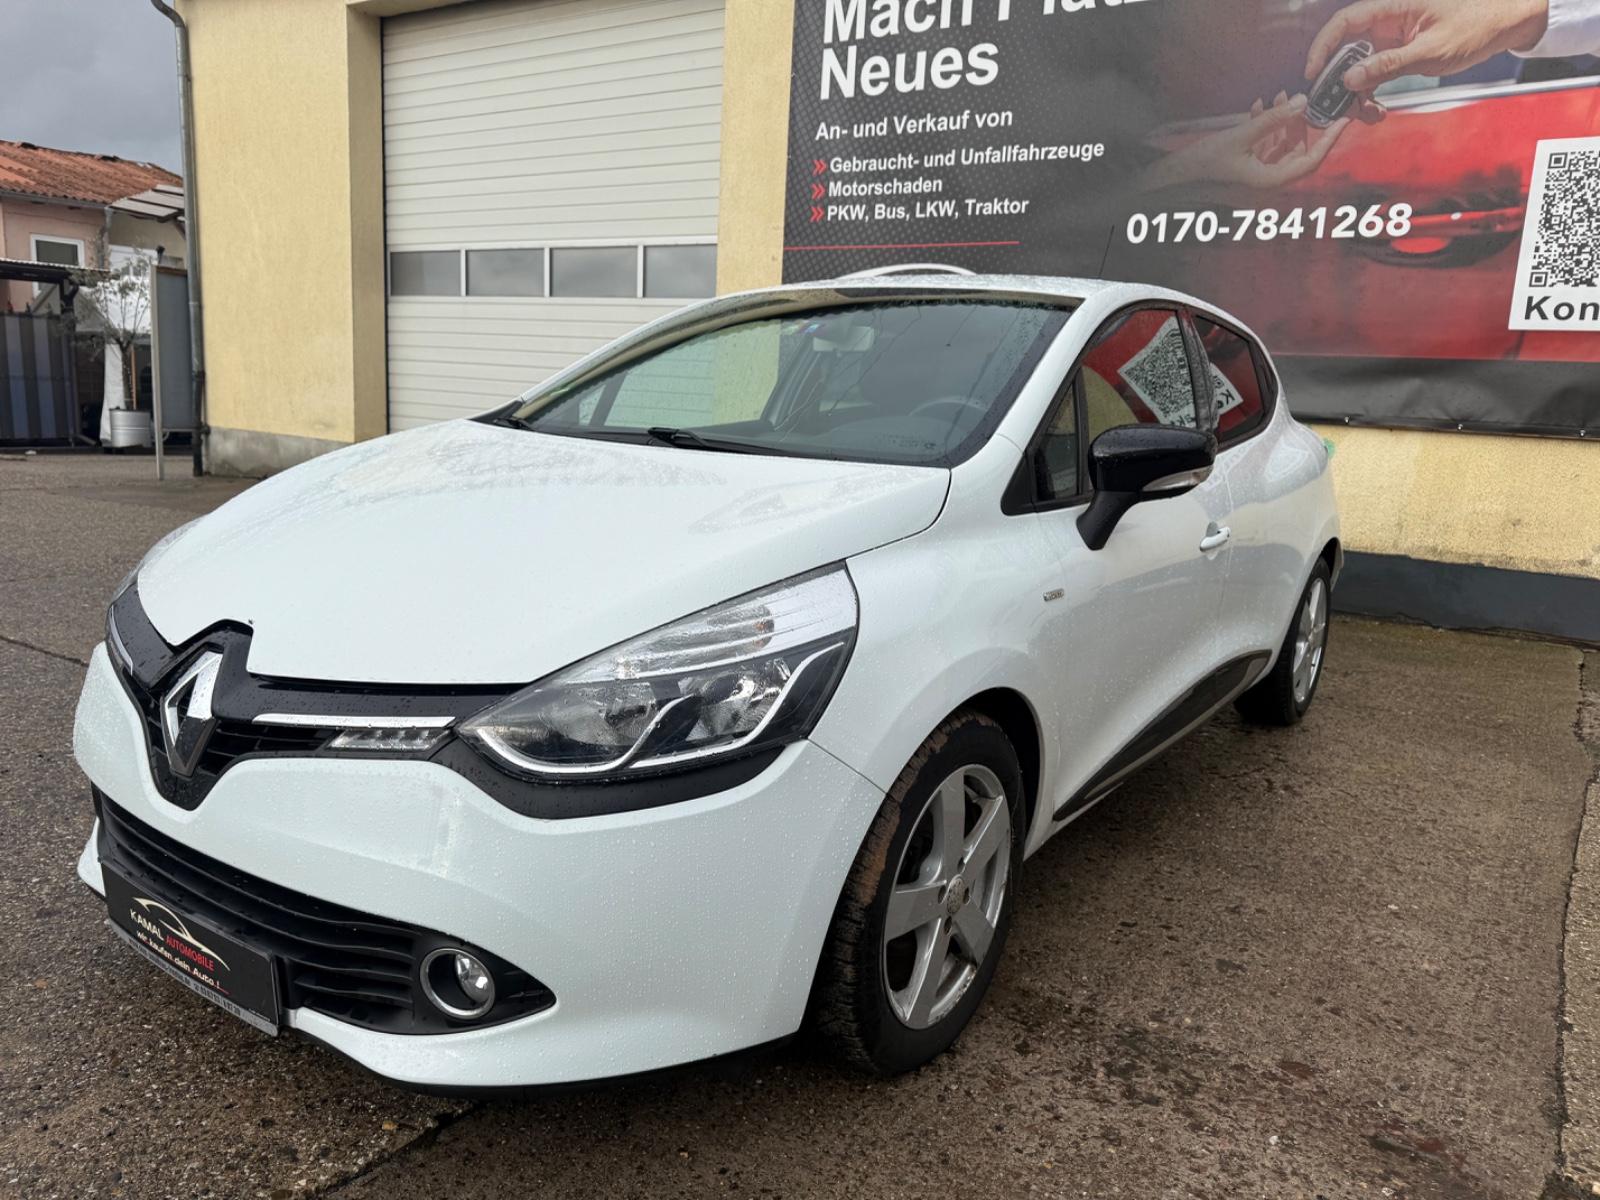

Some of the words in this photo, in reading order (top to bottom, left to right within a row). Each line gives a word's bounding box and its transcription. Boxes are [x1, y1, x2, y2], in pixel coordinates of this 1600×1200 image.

[820, 42, 999, 100] Neues
[815, 122, 848, 140] An-
[853, 118, 888, 138] und
[893, 110, 971, 135] Verkauf
[975, 110, 1014, 128] von
[829, 152, 919, 174] Gebraucht-
[923, 149, 955, 167] und
[960, 142, 1105, 165] Unfallfahrzeuge
[828, 176, 943, 197] Motorschaden
[827, 204, 869, 222] PKW,
[874, 203, 910, 221] Bus,
[915, 200, 959, 219] LKW,
[964, 197, 1030, 216] Traktor
[1126, 202, 1413, 244] 0170-7841268
[130, 908, 164, 941] KAMAL
[166, 935, 215, 971] AUTOMOBILE
